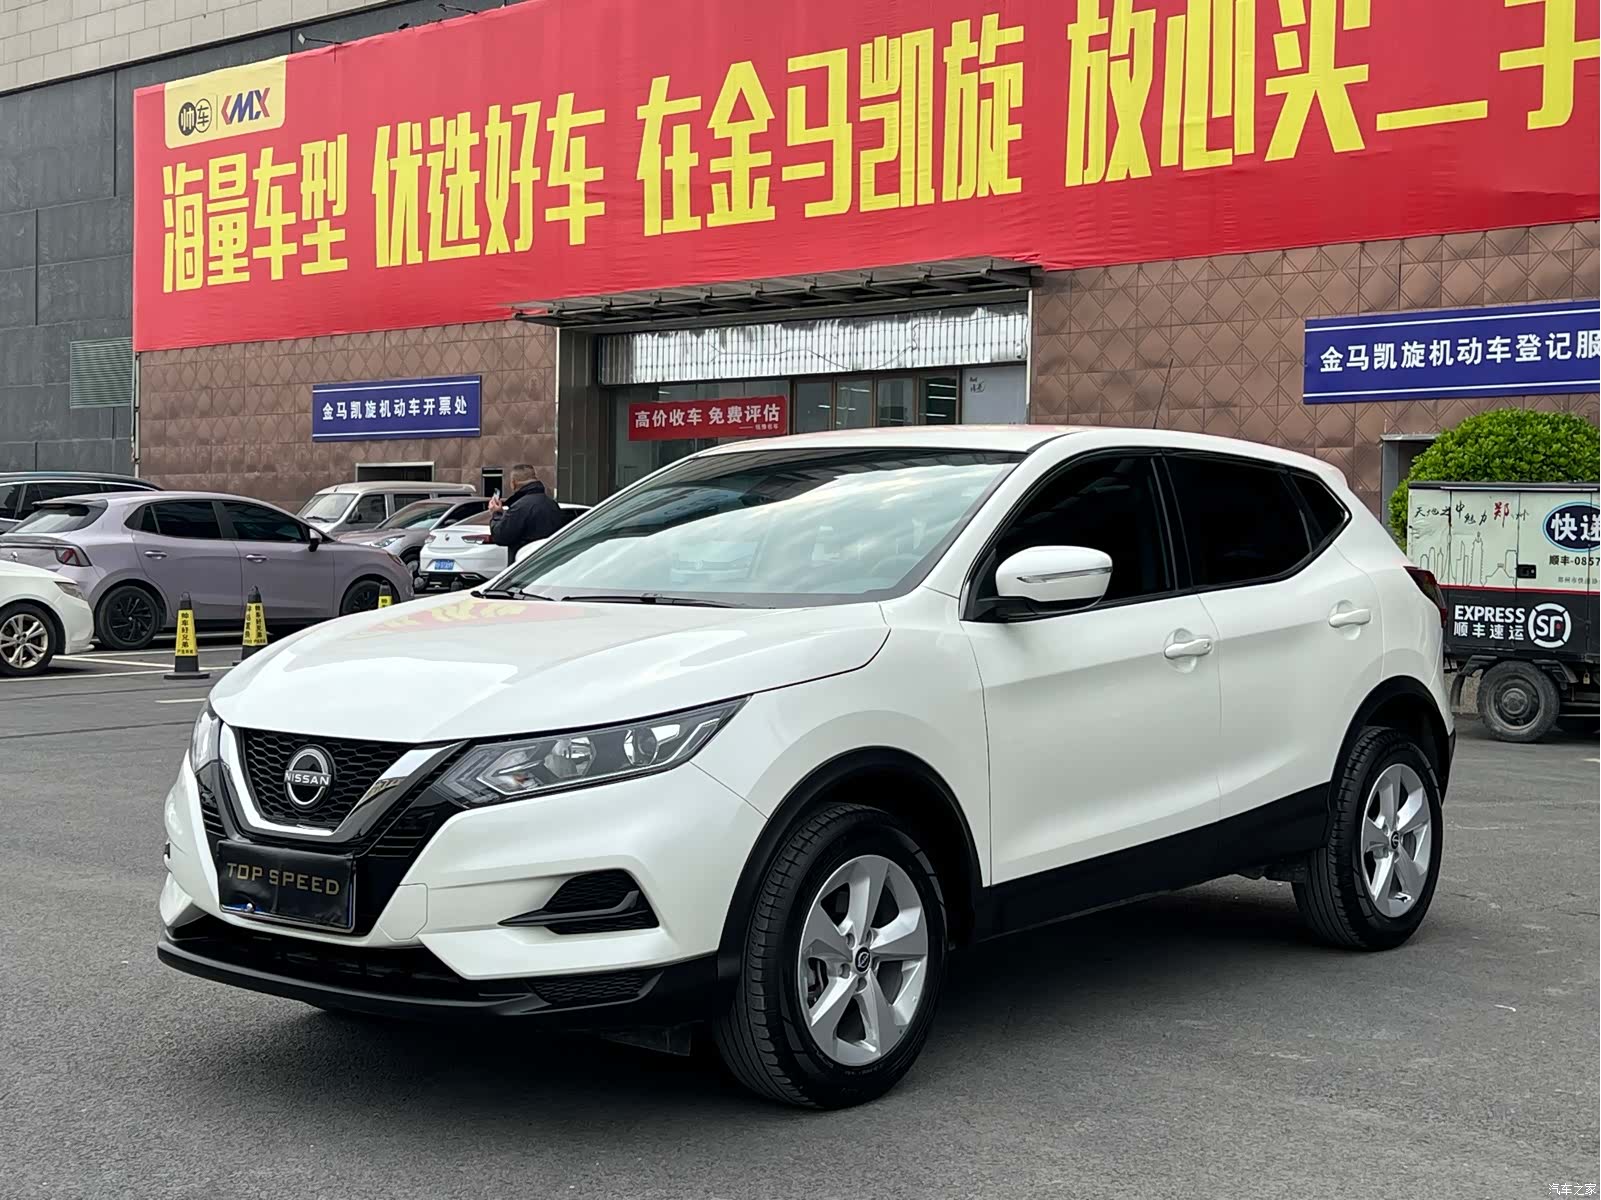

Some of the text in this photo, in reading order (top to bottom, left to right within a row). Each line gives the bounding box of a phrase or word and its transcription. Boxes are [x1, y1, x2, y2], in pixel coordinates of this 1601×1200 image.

[178, 101, 211, 135] 帅车
[163, 134, 348, 293] 海量车型
[372, 92, 606, 268] 优选好车
[636, 13, 1025, 237] 在金马凯旋
[1320, 329, 1600, 373] 金马凯旋机动车登记服
[322, 395, 468, 421] 金马凯旋机动车开票处
[635, 403, 781, 428] 高价收车 免费评估
[1454, 605, 1525, 623] EXPRESS
[1453, 621, 1525, 641] 顺丰速运
[285, 772, 331, 786] NISSAN
[226, 863, 340, 896] TOP SPEED
